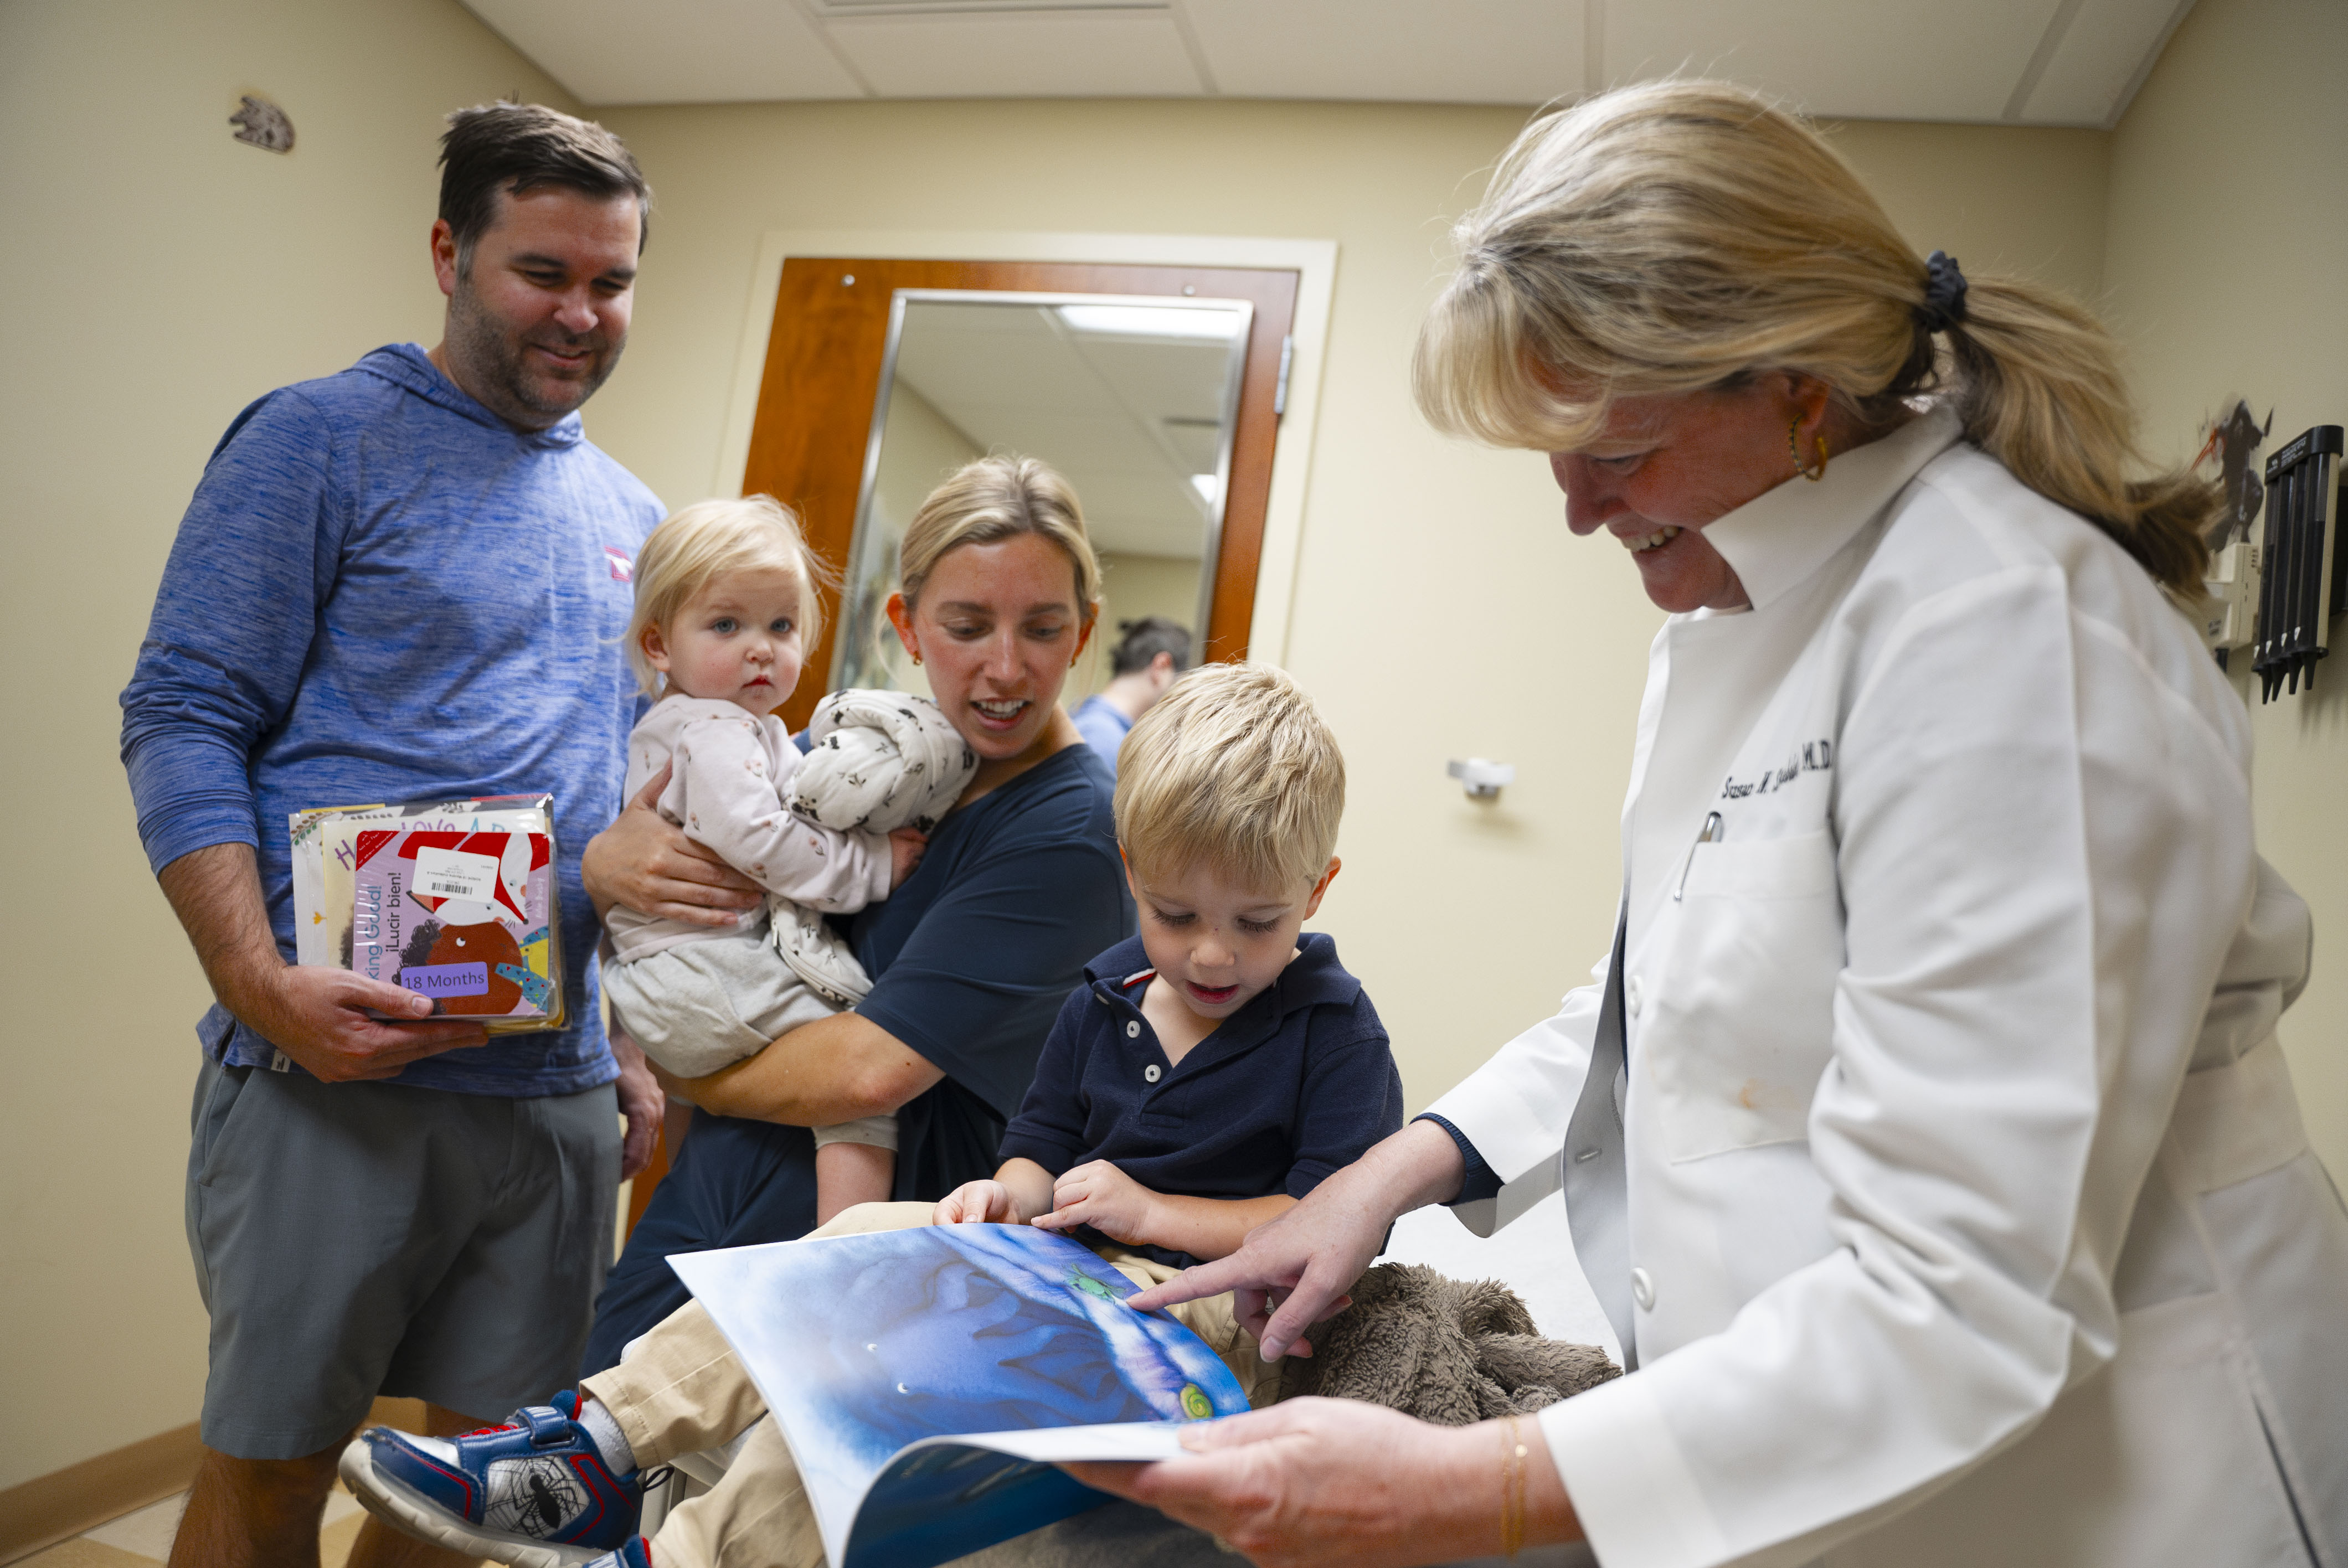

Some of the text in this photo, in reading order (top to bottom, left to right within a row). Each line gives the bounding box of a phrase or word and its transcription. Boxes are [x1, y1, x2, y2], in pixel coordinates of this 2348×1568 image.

[387, 872, 401, 908] bien!
[364, 885, 382, 939] Good!
[405, 972, 485, 989] 18 Months
